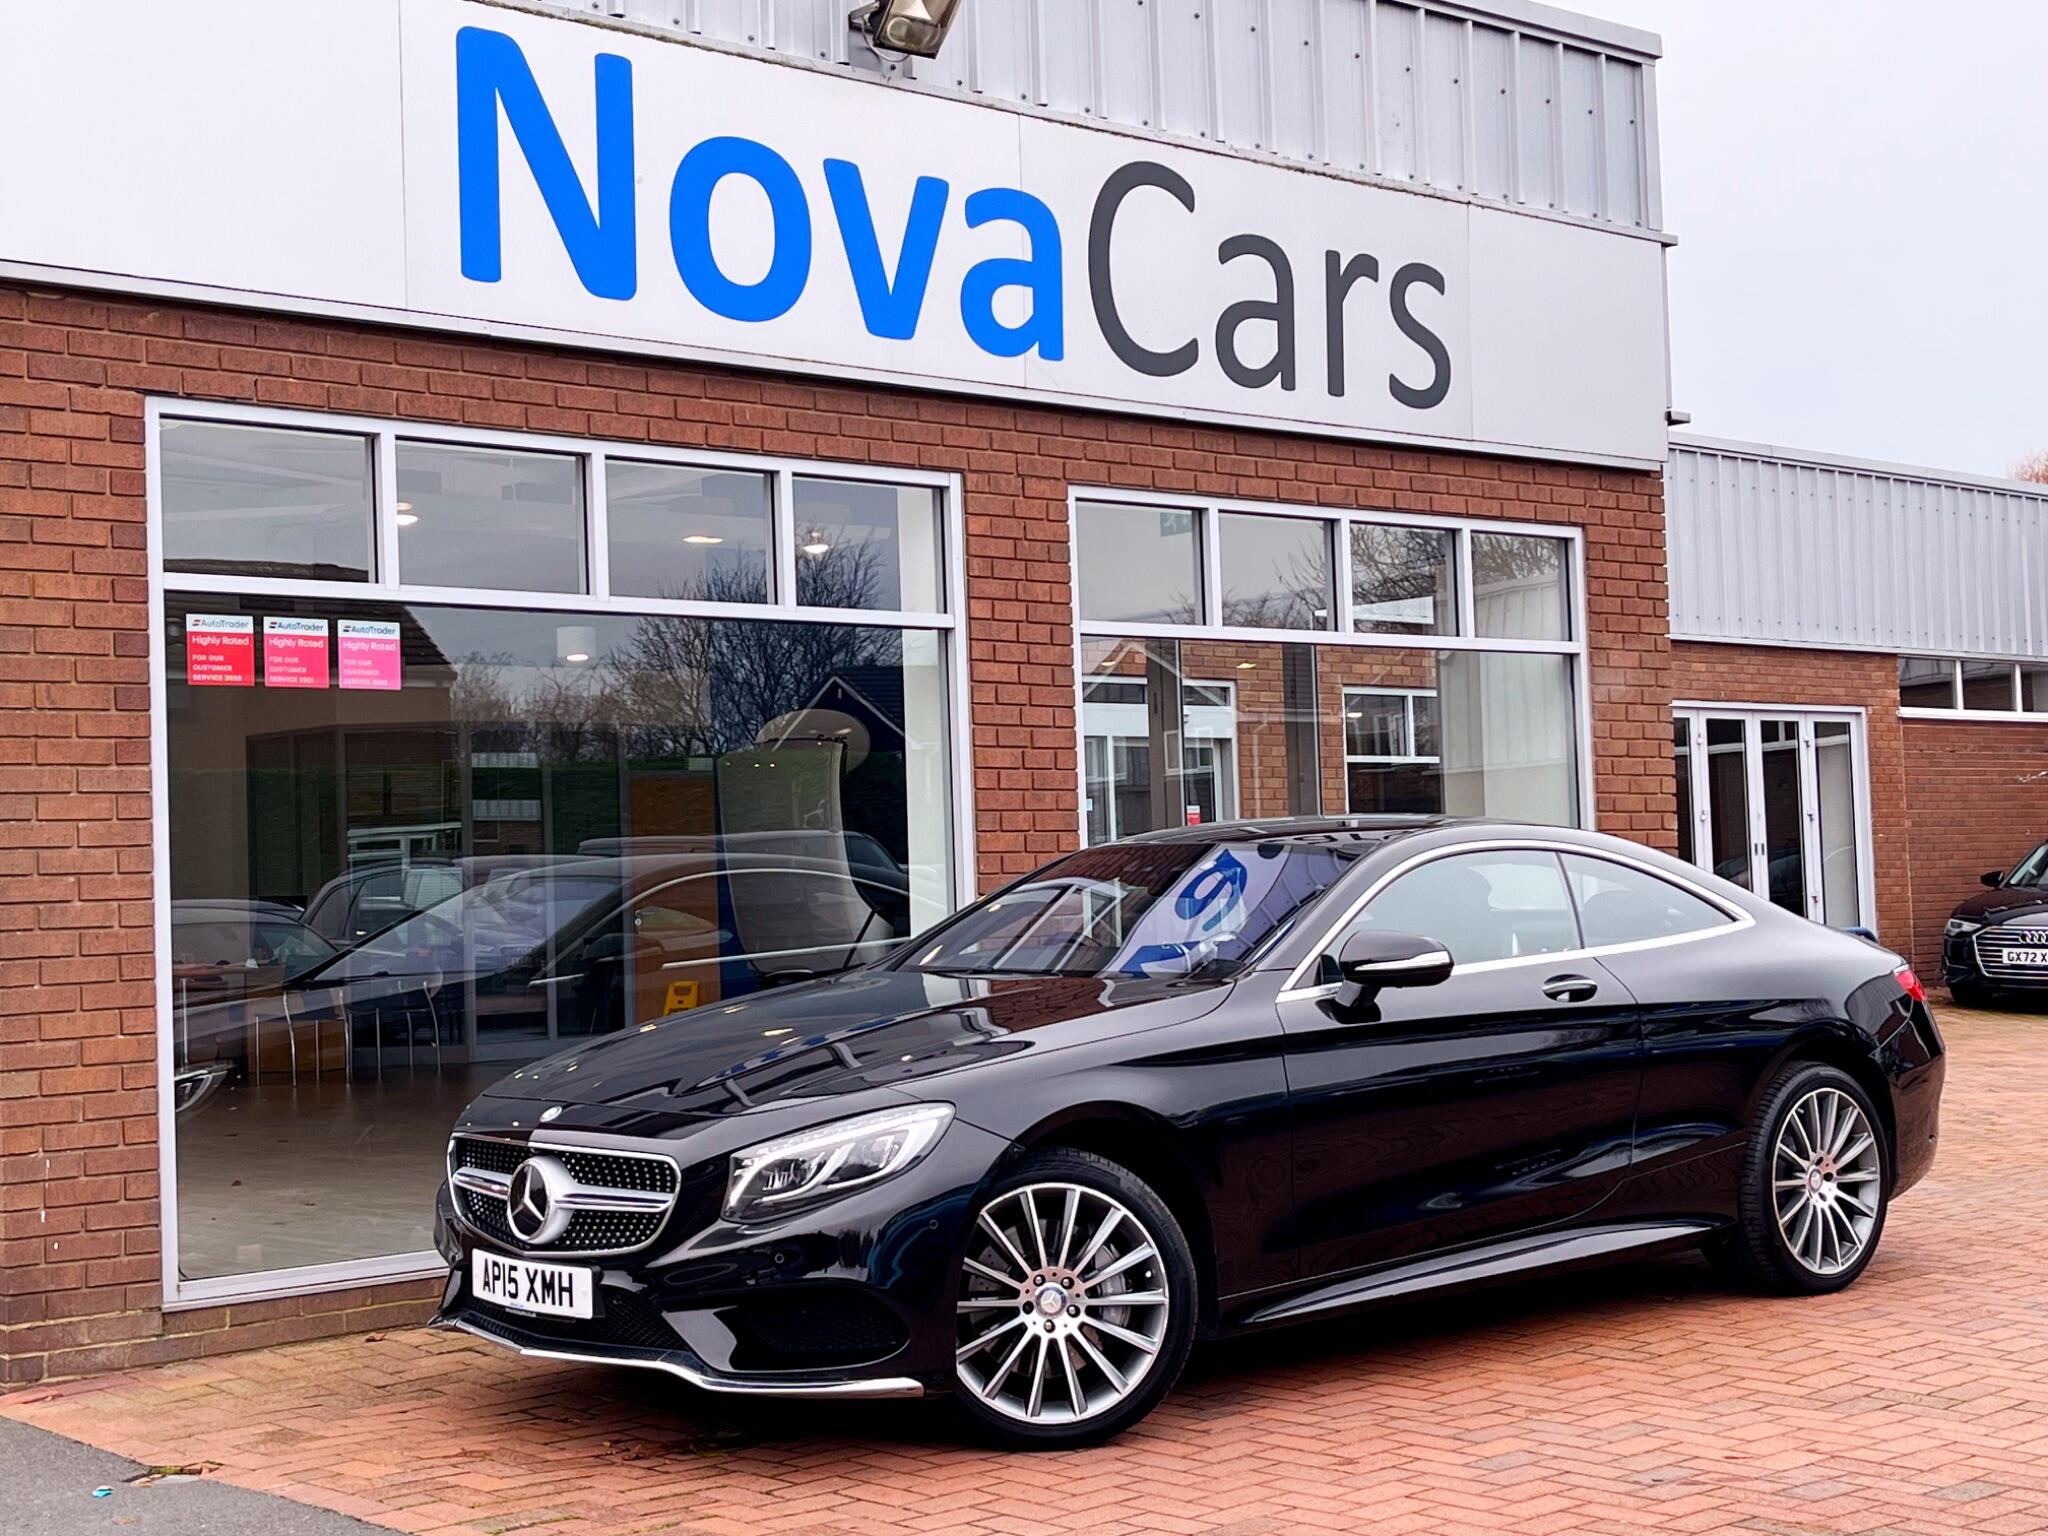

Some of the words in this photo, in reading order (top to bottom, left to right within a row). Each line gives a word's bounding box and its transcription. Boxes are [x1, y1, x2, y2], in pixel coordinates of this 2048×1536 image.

[201, 620, 249, 629] AutoTrader
[277, 622, 324, 631] AutoTrader
[351, 626, 396, 635] AutoTrader
[192, 635, 221, 646] Highly
[222, 637, 249, 645] Rated
[268, 638, 297, 648] Highly
[298, 639, 324, 648] Rated
[192, 664, 232, 672] CUSTOMER
[192, 674, 223, 682] SERVICE
[2007, 951, 2037, 963] GX72
[483, 1258, 518, 1299] AP15
[525, 1267, 574, 1308] XMH
